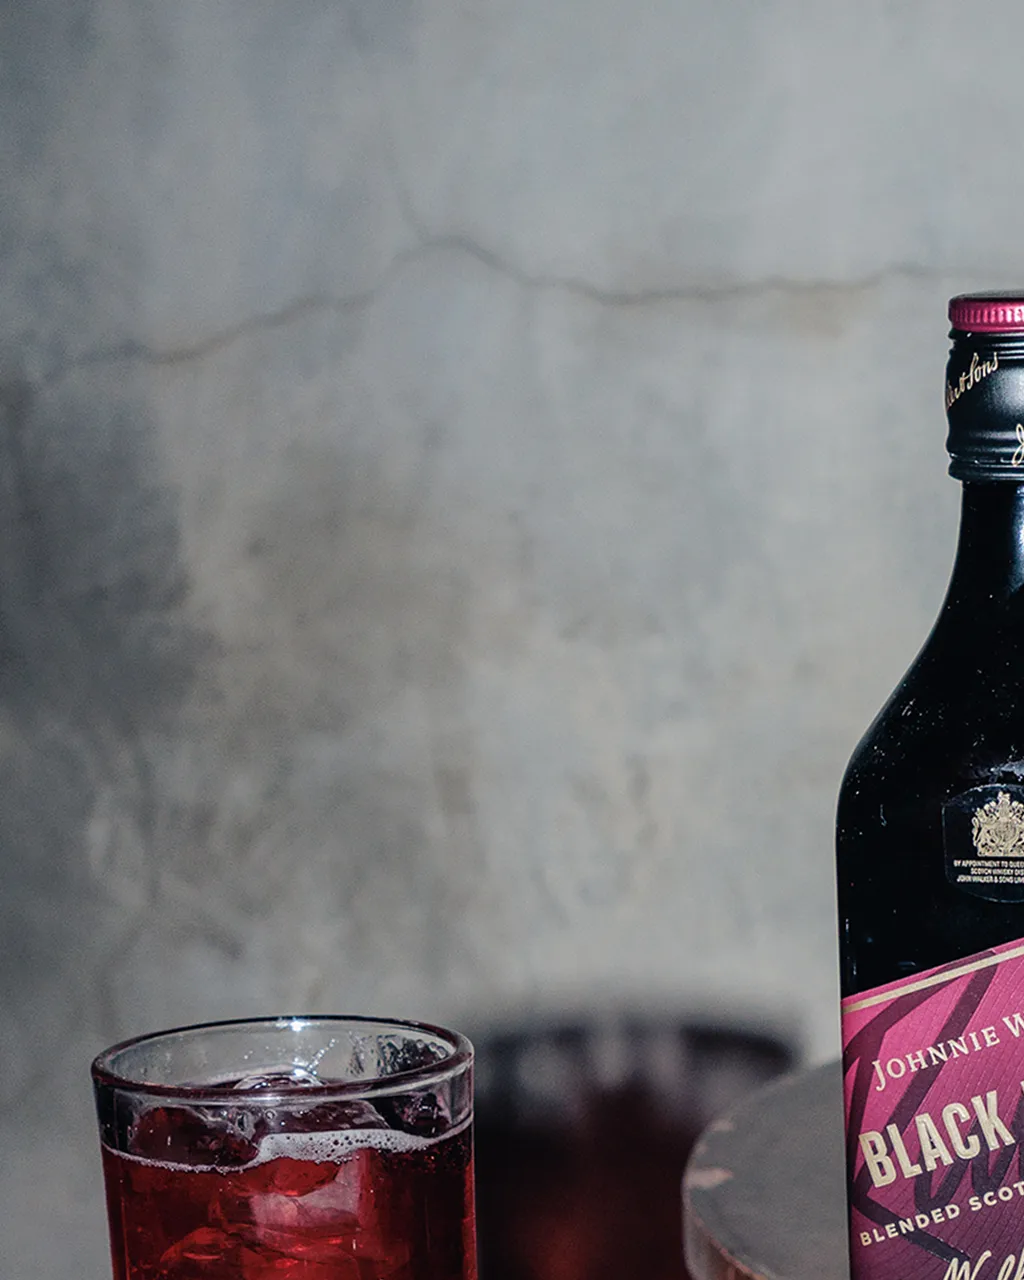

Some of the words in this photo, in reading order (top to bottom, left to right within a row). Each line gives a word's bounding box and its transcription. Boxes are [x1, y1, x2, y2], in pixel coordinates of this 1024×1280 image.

[872, 1025, 1001, 1091] JOHNNIE
[858, 1090, 1016, 1188] BLACK
[860, 1205, 961, 1246] BLENDED
